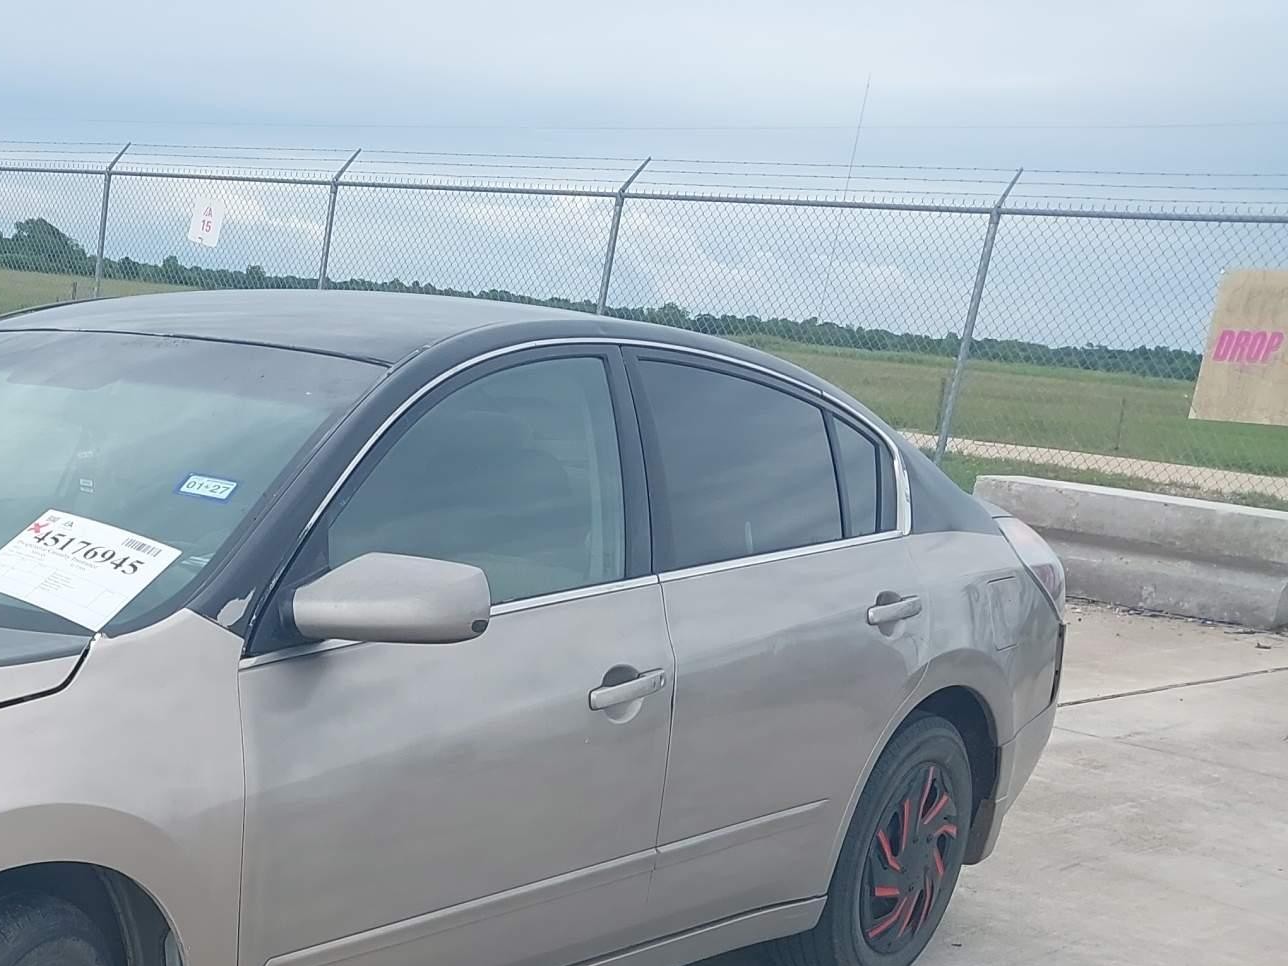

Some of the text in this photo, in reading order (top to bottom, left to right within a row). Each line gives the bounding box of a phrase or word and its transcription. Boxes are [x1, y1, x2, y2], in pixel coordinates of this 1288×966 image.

[202, 219, 213, 233] 15
[1213, 330, 1285, 364] DROP
[33, 530, 145, 575] 45176945
